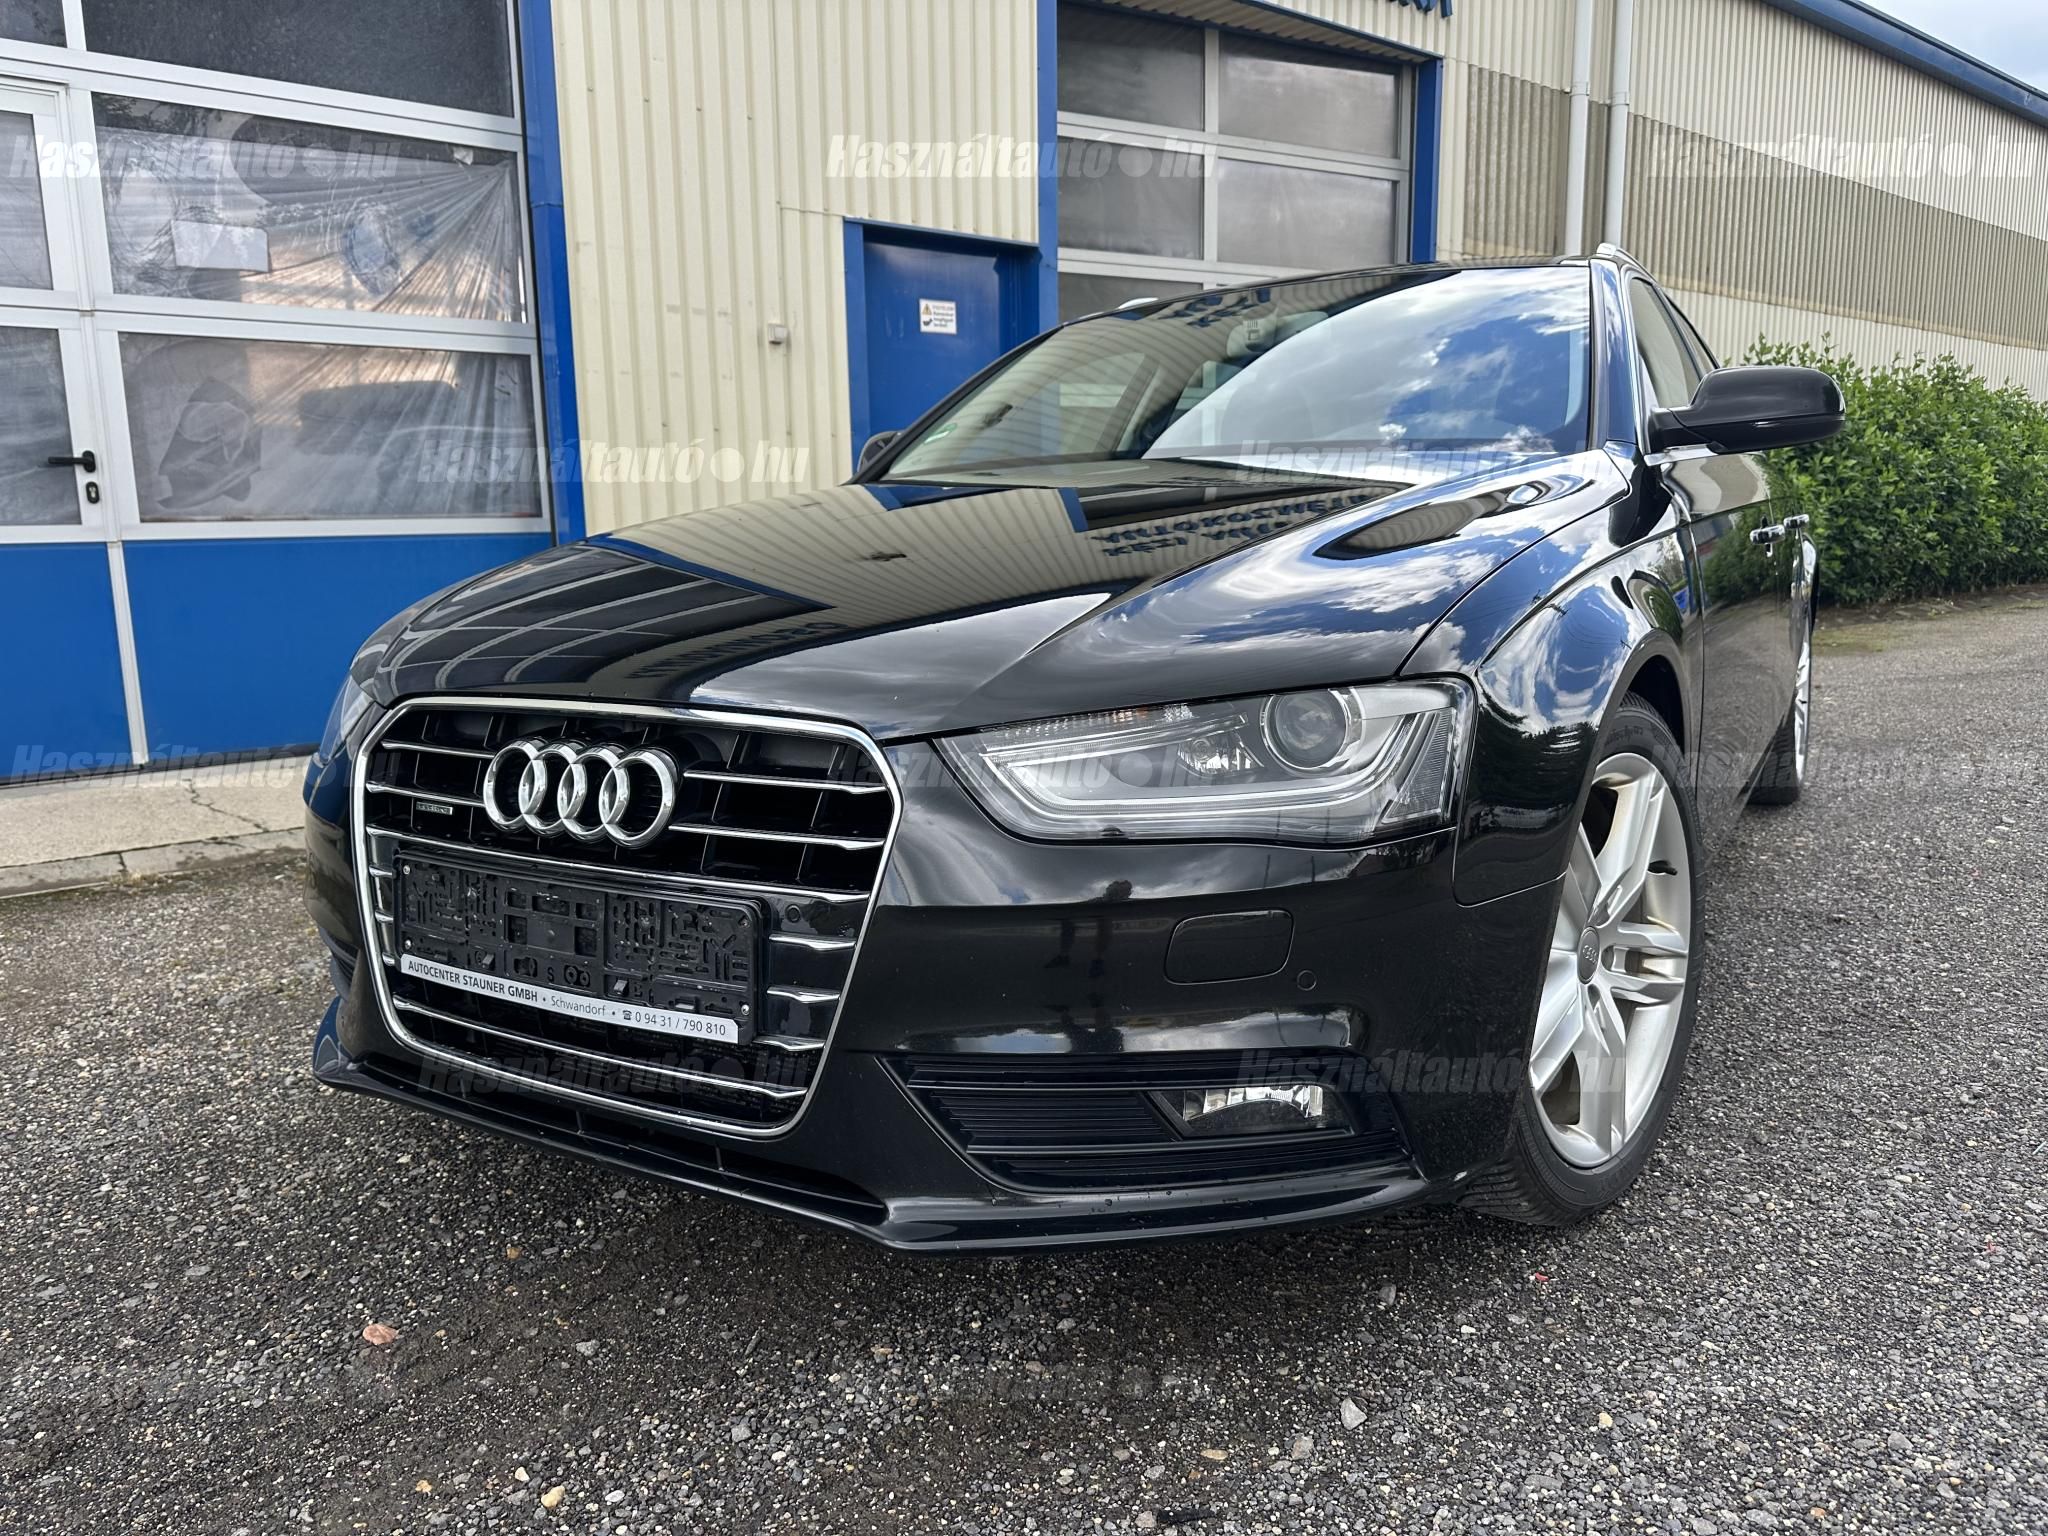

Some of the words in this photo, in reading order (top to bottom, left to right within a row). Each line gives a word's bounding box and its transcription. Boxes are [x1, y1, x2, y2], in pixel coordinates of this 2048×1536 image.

[408, 960, 461, 984] AUTOCENTER
[463, 975, 506, 995] STAUNER
[507, 985, 538, 1003] GMBH
[551, 995, 606, 1015] Schwandorf
[644, 1013, 657, 1025] 94
[660, 1015, 672, 1028] 31
[683, 1018, 703, 1032] 790
[706, 1022, 726, 1036] 810
